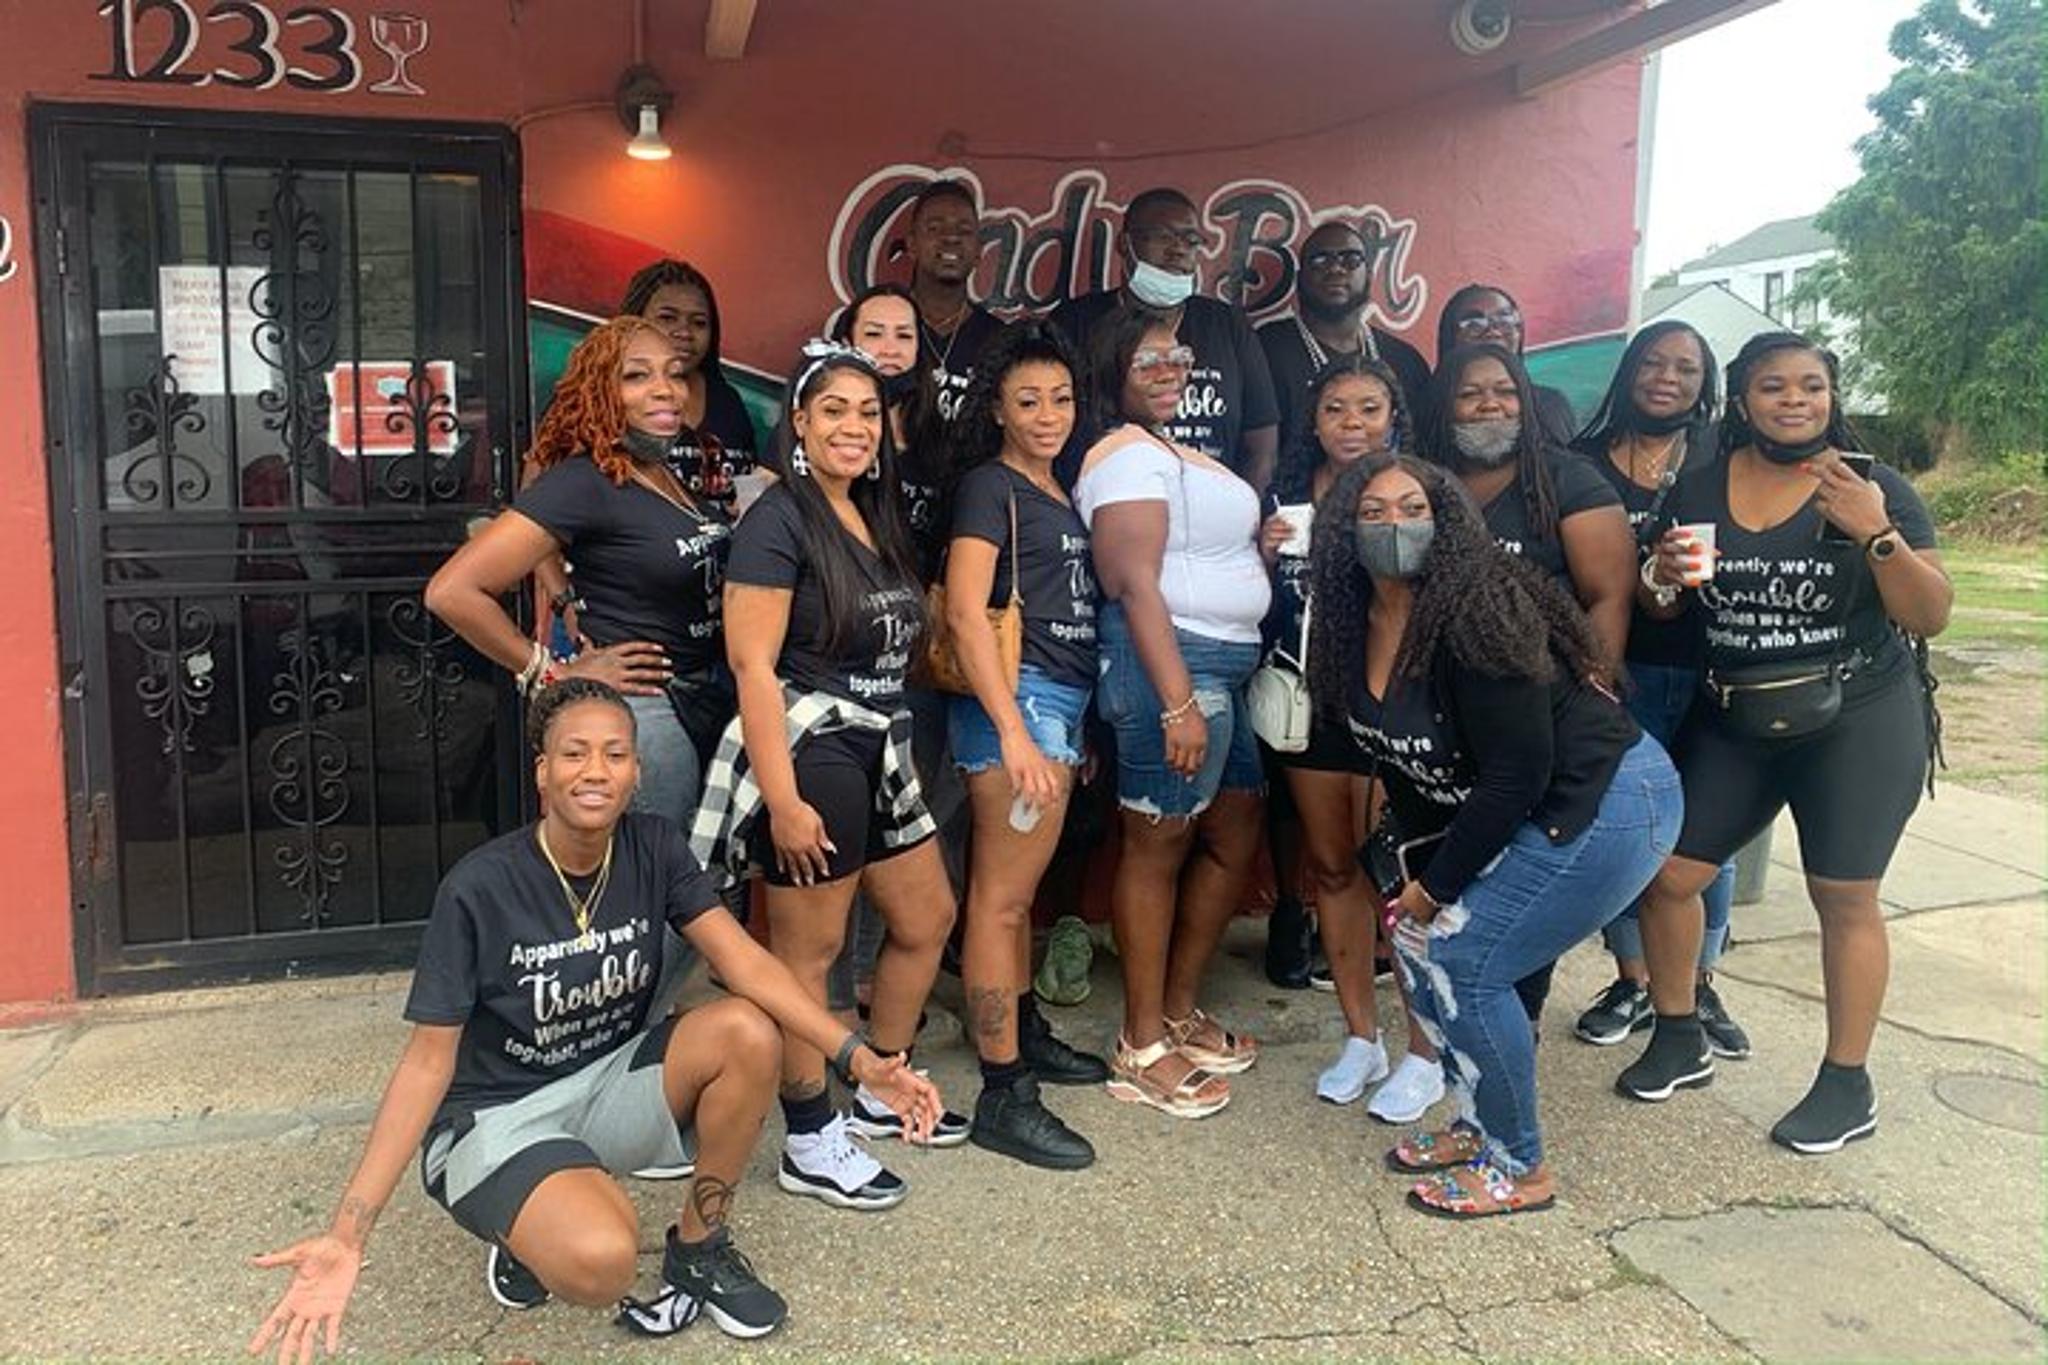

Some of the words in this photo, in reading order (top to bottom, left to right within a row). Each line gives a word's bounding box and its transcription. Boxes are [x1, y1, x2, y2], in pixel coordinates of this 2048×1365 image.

[88, 0, 363, 94] 1233
[1203, 179, 1427, 331] Br
[1717, 556, 1771, 576] rently
[1779, 558, 1835, 576] we're
[1759, 613, 1783, 627] we
[1758, 628, 1797, 649] who
[517, 948, 650, 1022] Trouble
[534, 1019, 582, 1047] When
